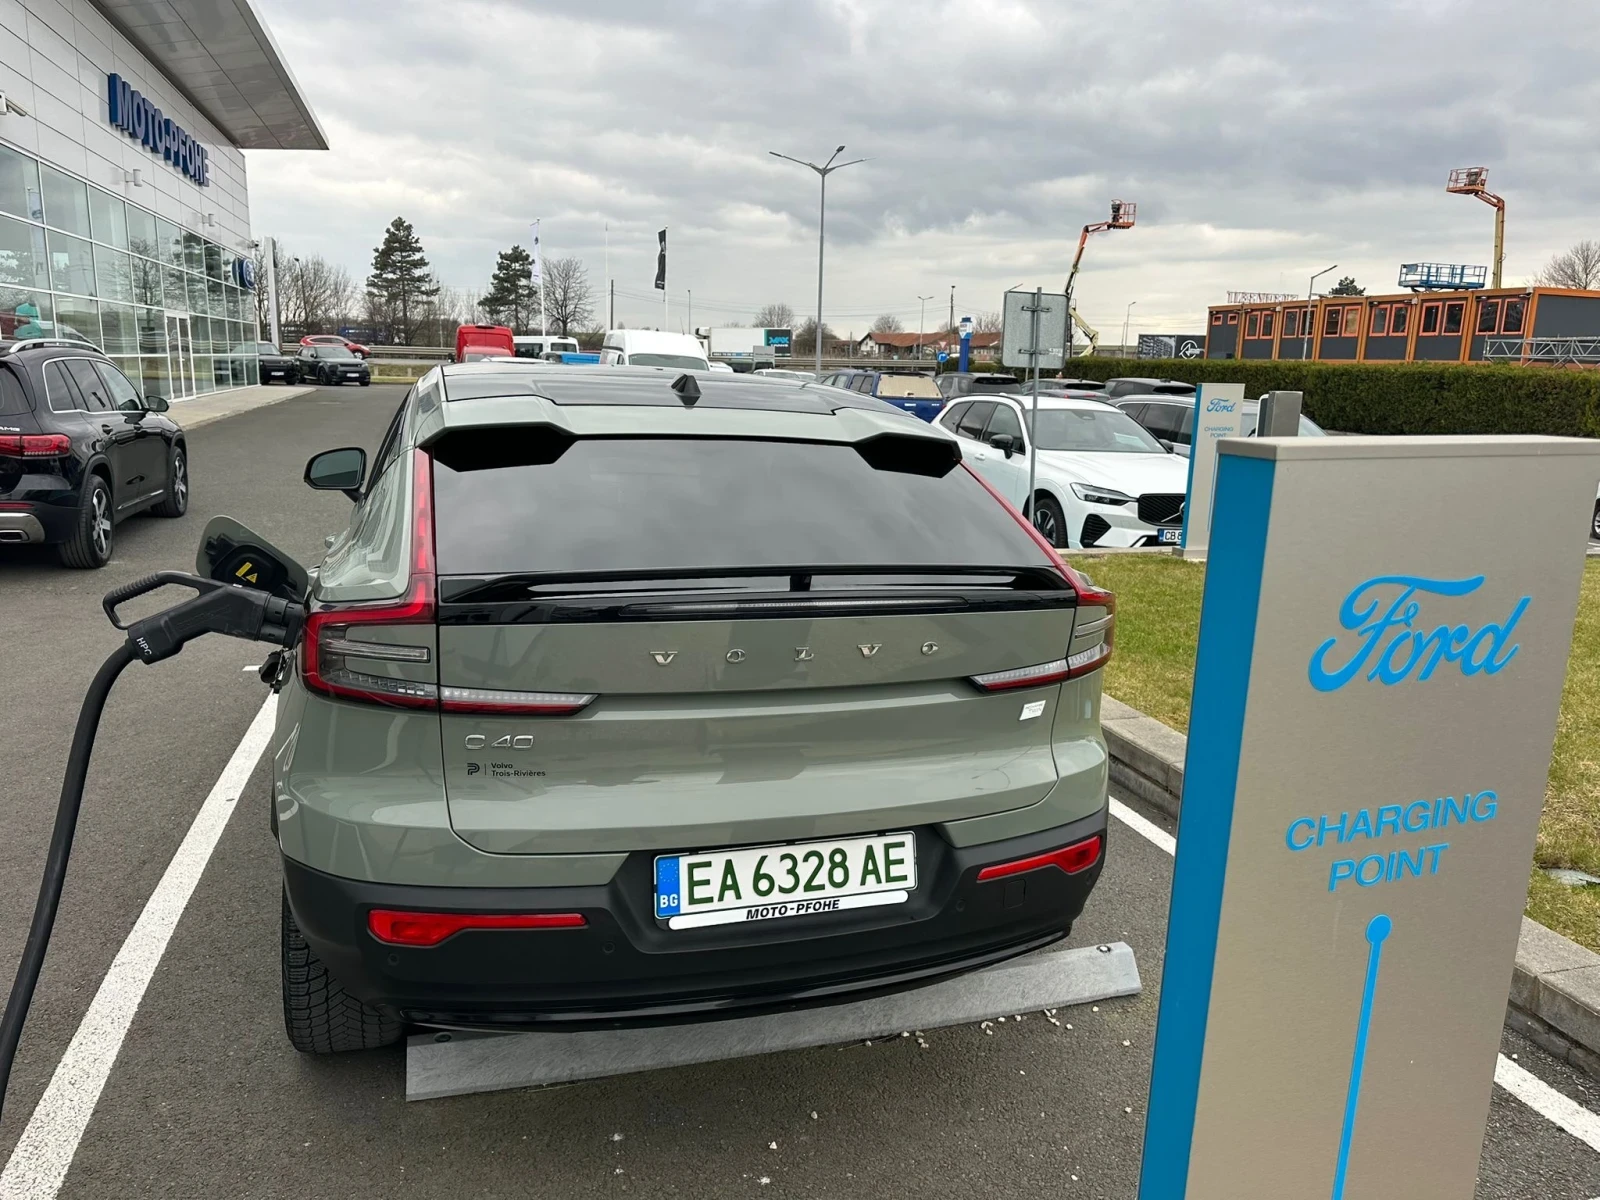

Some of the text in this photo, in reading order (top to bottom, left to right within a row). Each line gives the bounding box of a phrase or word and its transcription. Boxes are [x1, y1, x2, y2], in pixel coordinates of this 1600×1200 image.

[108, 73, 209, 187] MOTO-PFOHE
[1206, 398, 1237, 412] Ford
[1164, 531, 1176, 540] CB
[1308, 575, 1532, 692] Ford
[136, 637, 152, 656] HPC
[650, 641, 939, 666] VOLVO
[1285, 789, 1498, 851] CHARGING
[687, 841, 908, 905] EA 6328 AE
[1328, 843, 1450, 892] POINT
[660, 893, 679, 908] BG
[746, 899, 840, 920] MOTO-PFOHE
